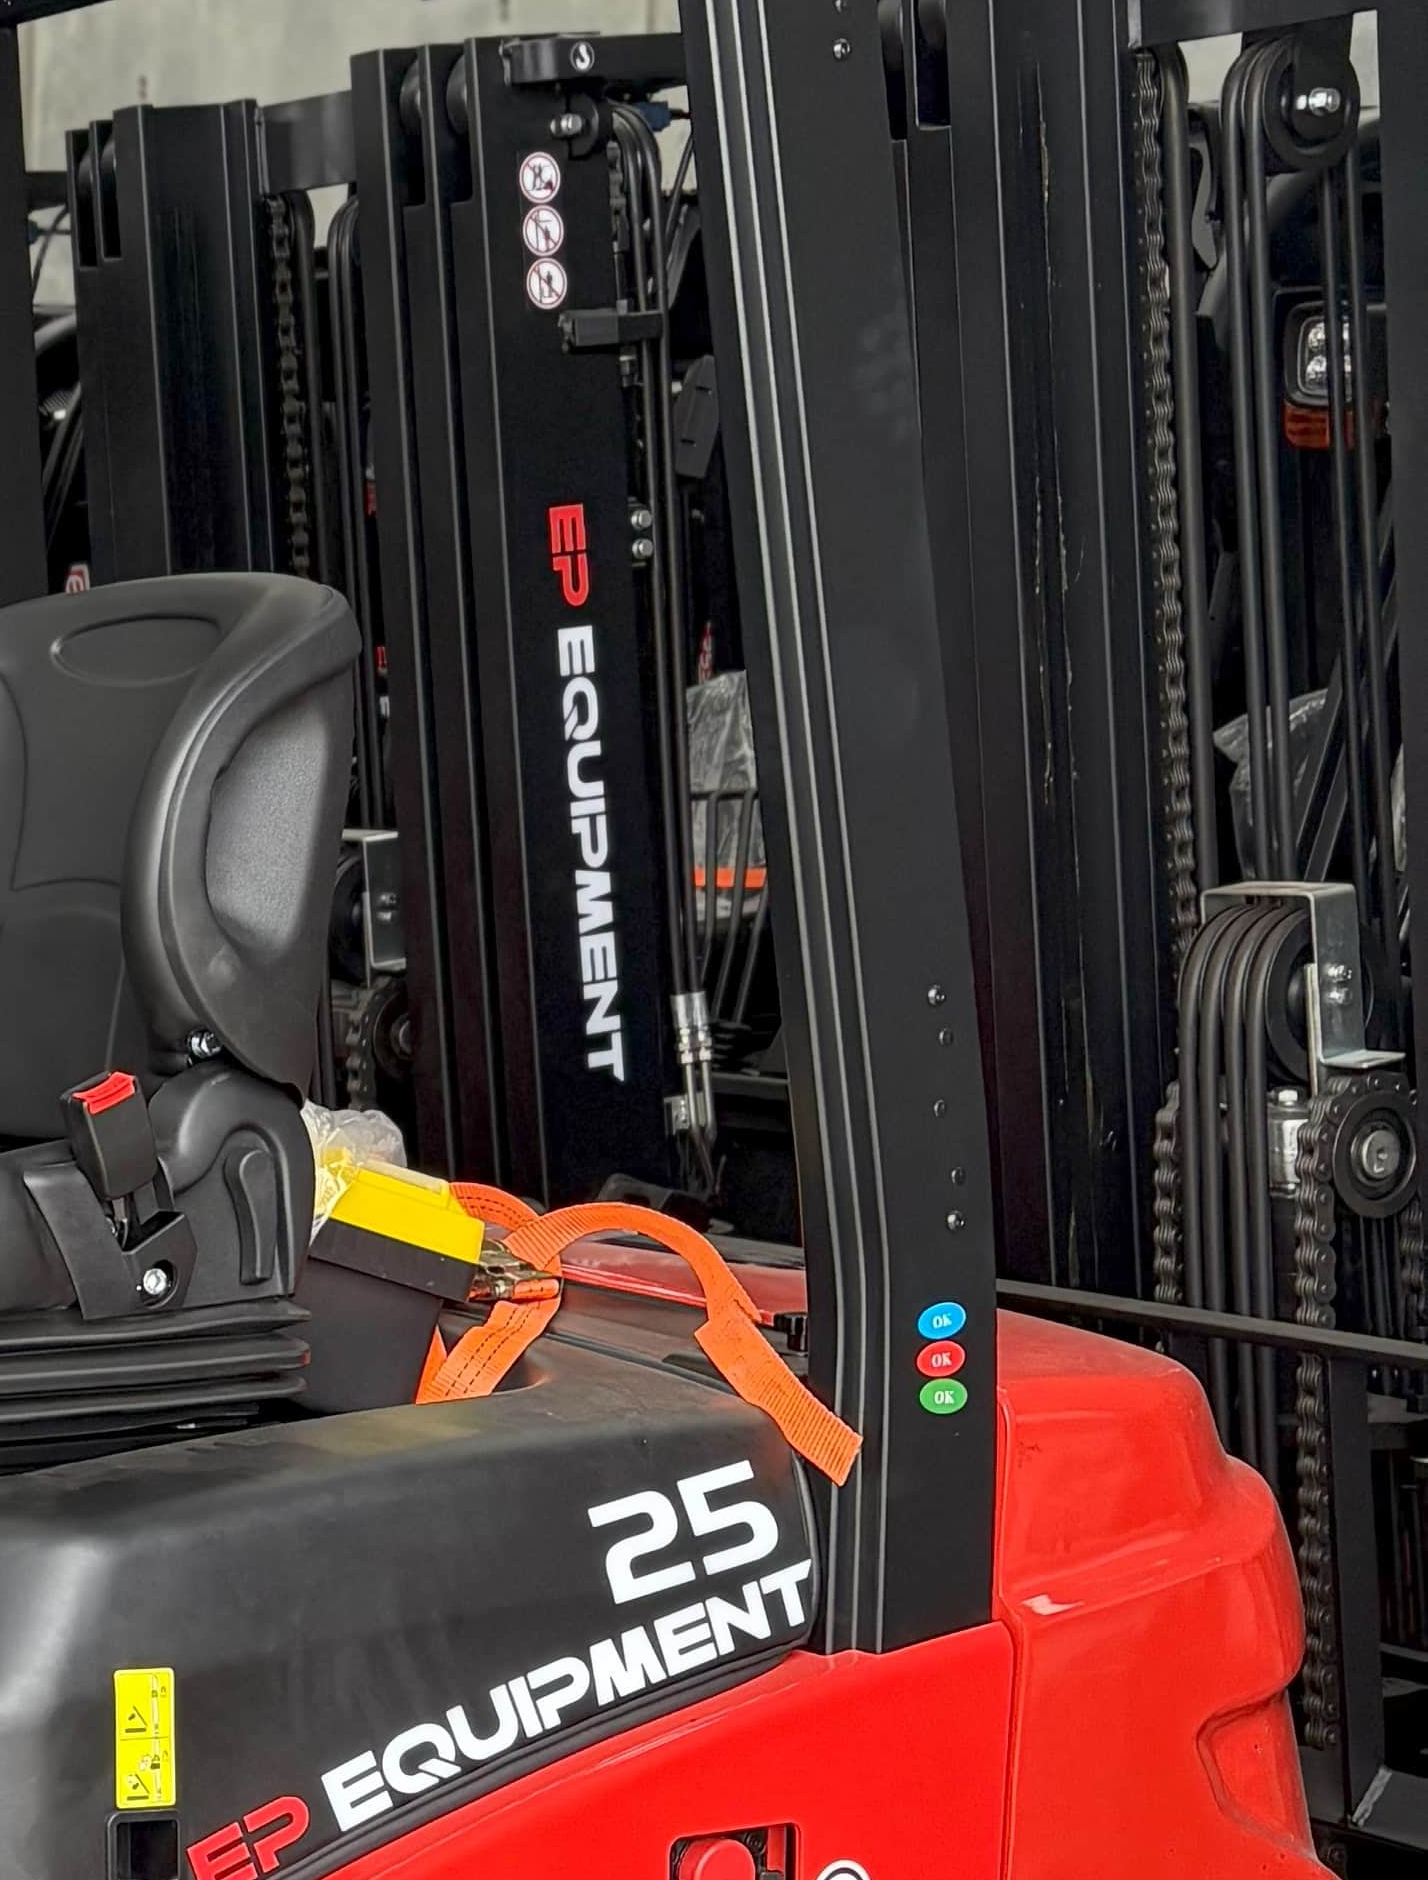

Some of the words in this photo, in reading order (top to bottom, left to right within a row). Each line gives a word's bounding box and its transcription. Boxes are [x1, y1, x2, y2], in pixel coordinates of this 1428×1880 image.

[548, 503, 590, 608] EP
[557, 625, 625, 1084] EQUIPMENT
[931, 1352, 952, 1368] OK
[932, 1313, 953, 1329] OK
[934, 1390, 955, 1405] OK
[588, 1459, 780, 1606] 25
[320, 1557, 812, 1832] EQUIPMENT
